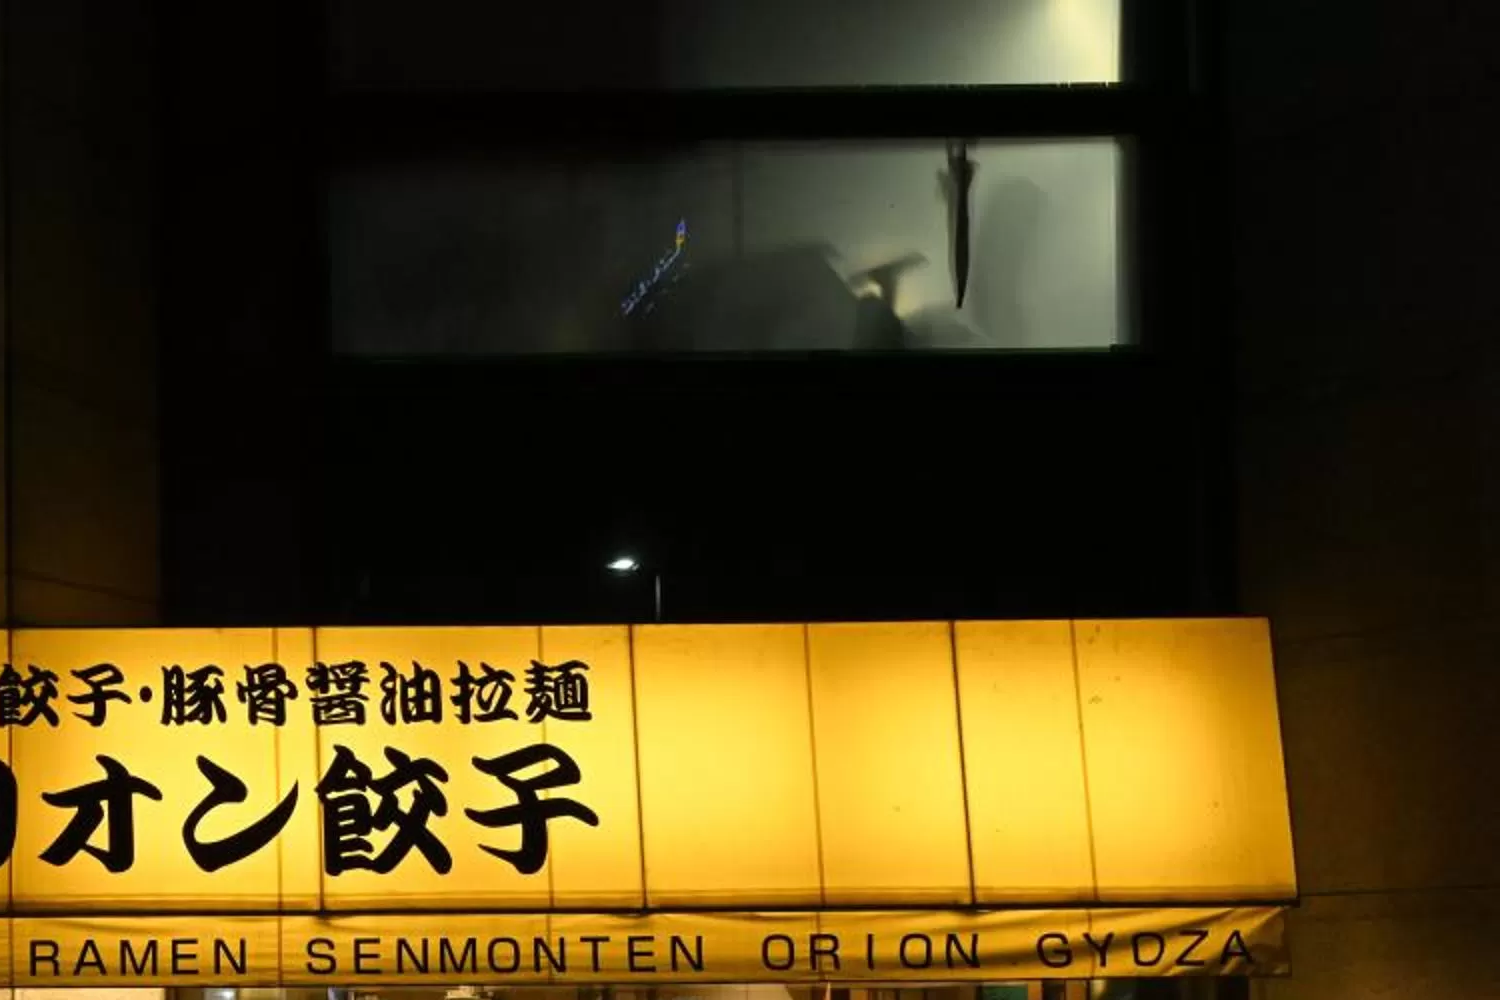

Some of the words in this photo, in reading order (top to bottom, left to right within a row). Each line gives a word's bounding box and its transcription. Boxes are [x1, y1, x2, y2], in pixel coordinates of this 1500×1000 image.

[29, 937, 248, 976] RAMEN
[305, 935, 706, 974] SENMONTEN
[761, 932, 980, 971] ORION
[1036, 929, 1255, 967] GYOZA
